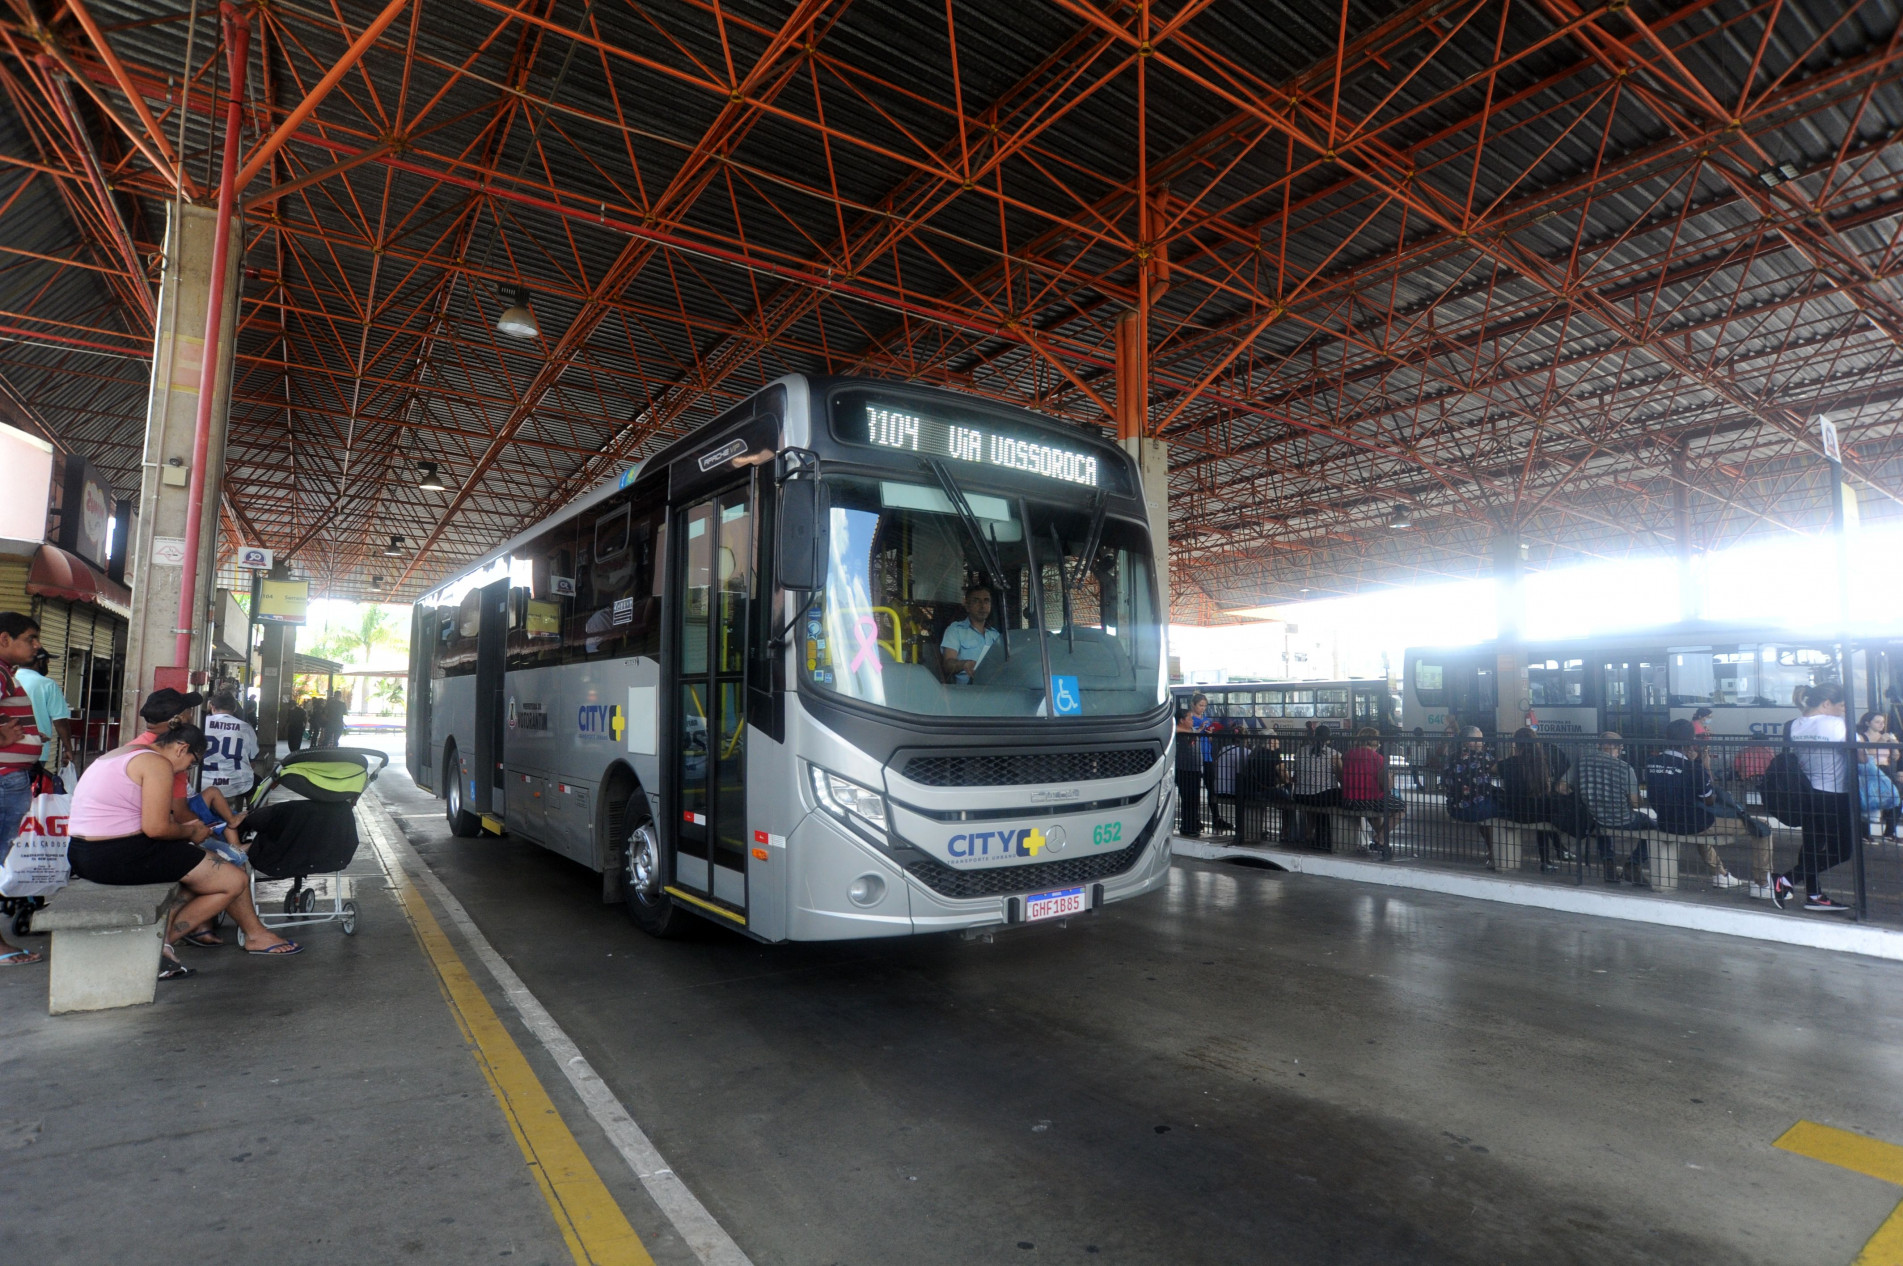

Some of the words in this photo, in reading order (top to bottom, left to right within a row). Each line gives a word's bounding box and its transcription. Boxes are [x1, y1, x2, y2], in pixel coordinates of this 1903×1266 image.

[991, 434, 1097, 486] VOSSOROCA
[209, 721, 240, 731] BATISTA
[578, 705, 608, 732] CITY
[203, 735, 243, 771] 24
[947, 829, 1016, 858] CITY
[1093, 821, 1122, 846] 652
[947, 856, 989, 865] TRANSPORTE
[1032, 896, 1079, 918] GHF1B85
